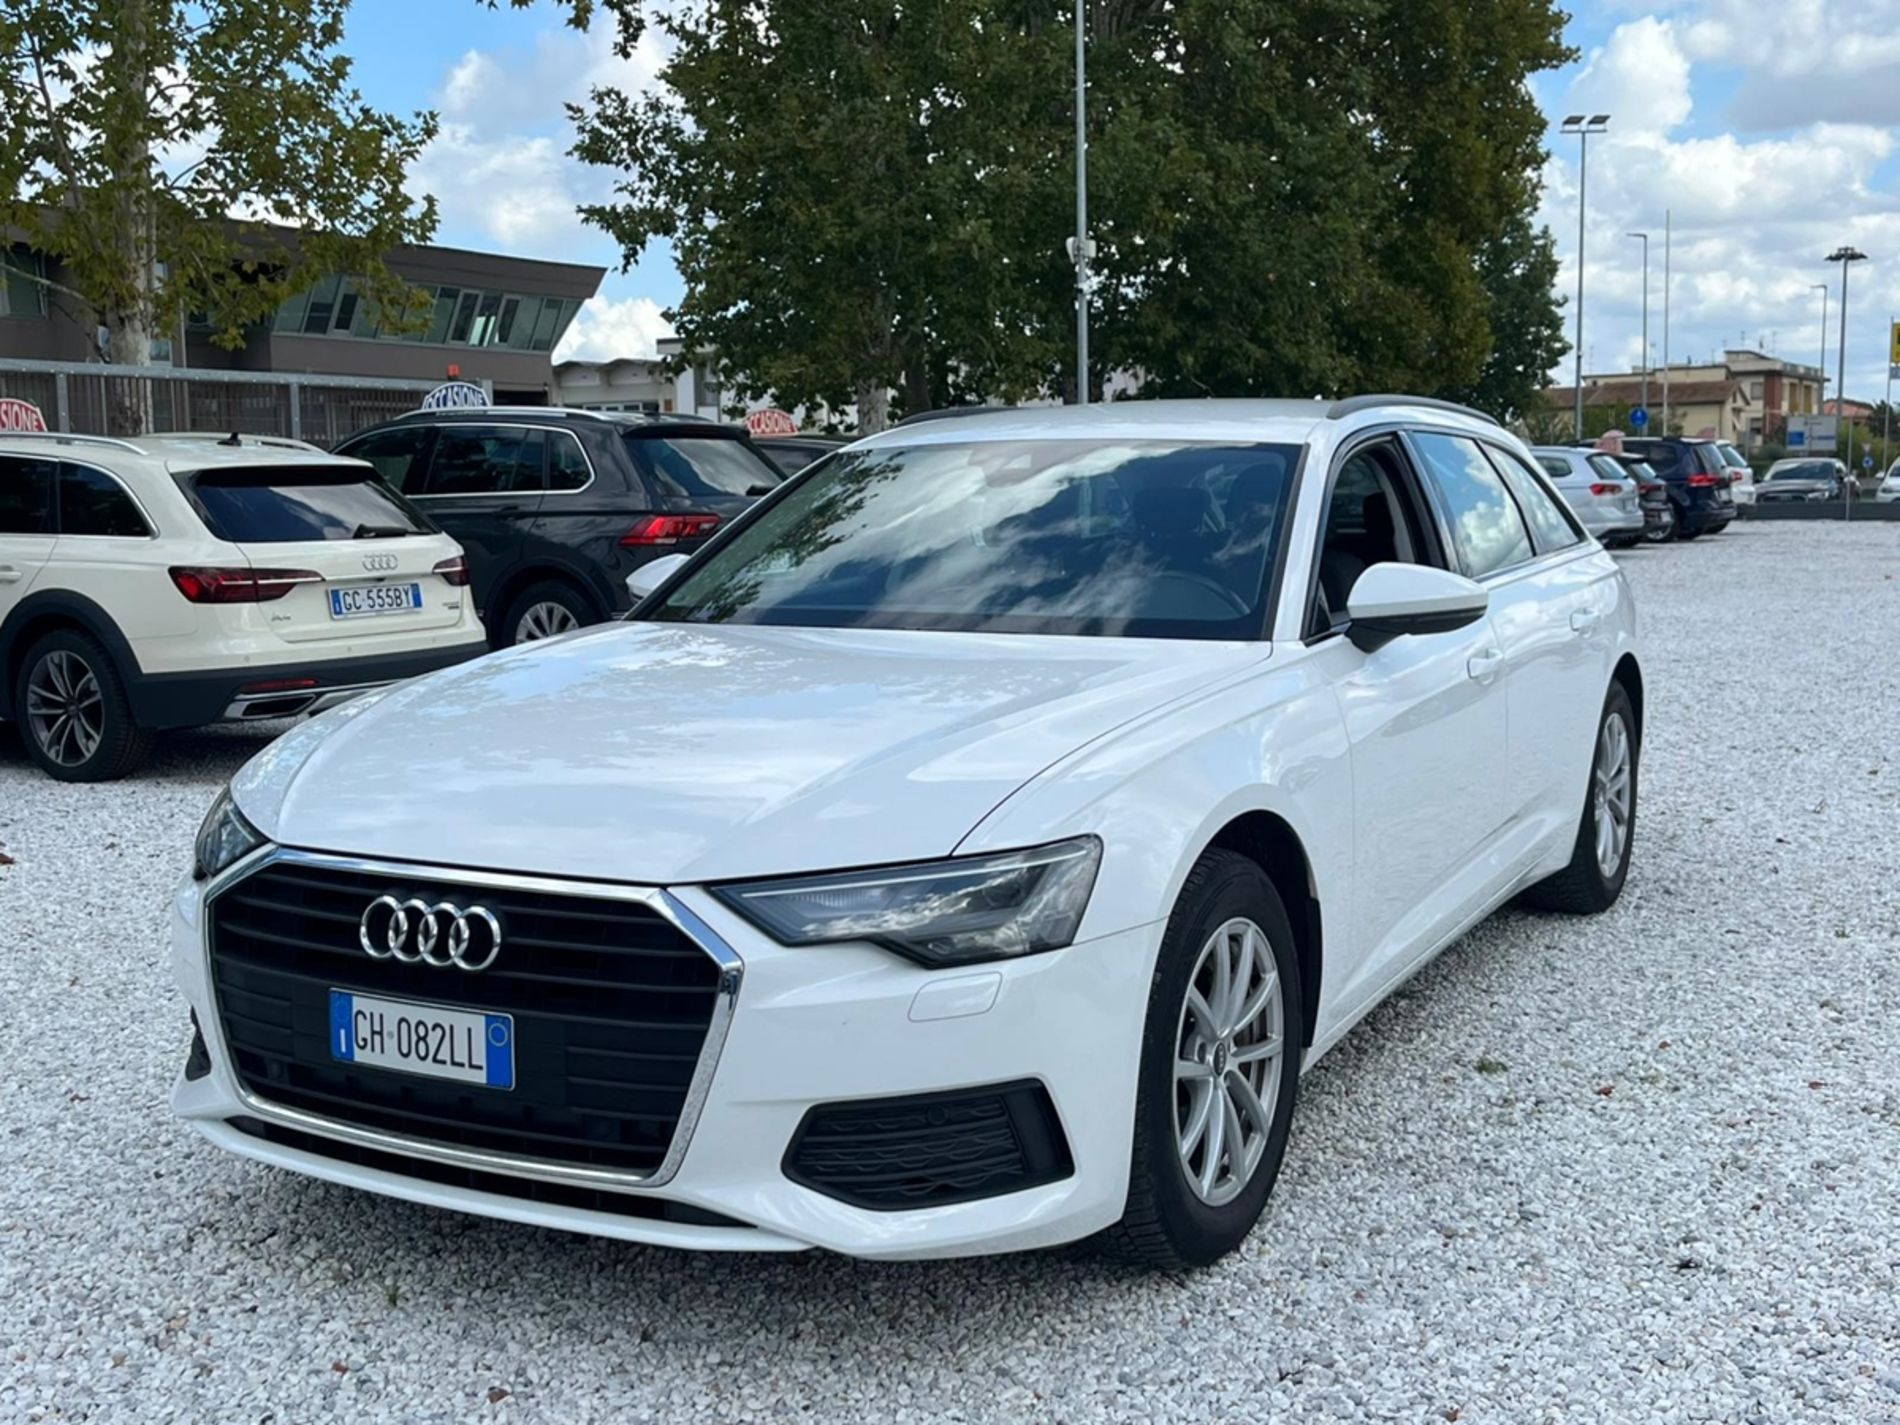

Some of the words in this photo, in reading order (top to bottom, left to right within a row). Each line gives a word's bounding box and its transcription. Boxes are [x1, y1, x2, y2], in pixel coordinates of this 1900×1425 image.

[425, 385, 484, 410] OCCASIONE
[0, 402, 39, 432] SIONE
[746, 411, 793, 432] CCASIONE
[366, 586, 411, 609] 555BY
[353, 1009, 385, 1055] GH
[396, 1016, 484, 1071] 082LL
